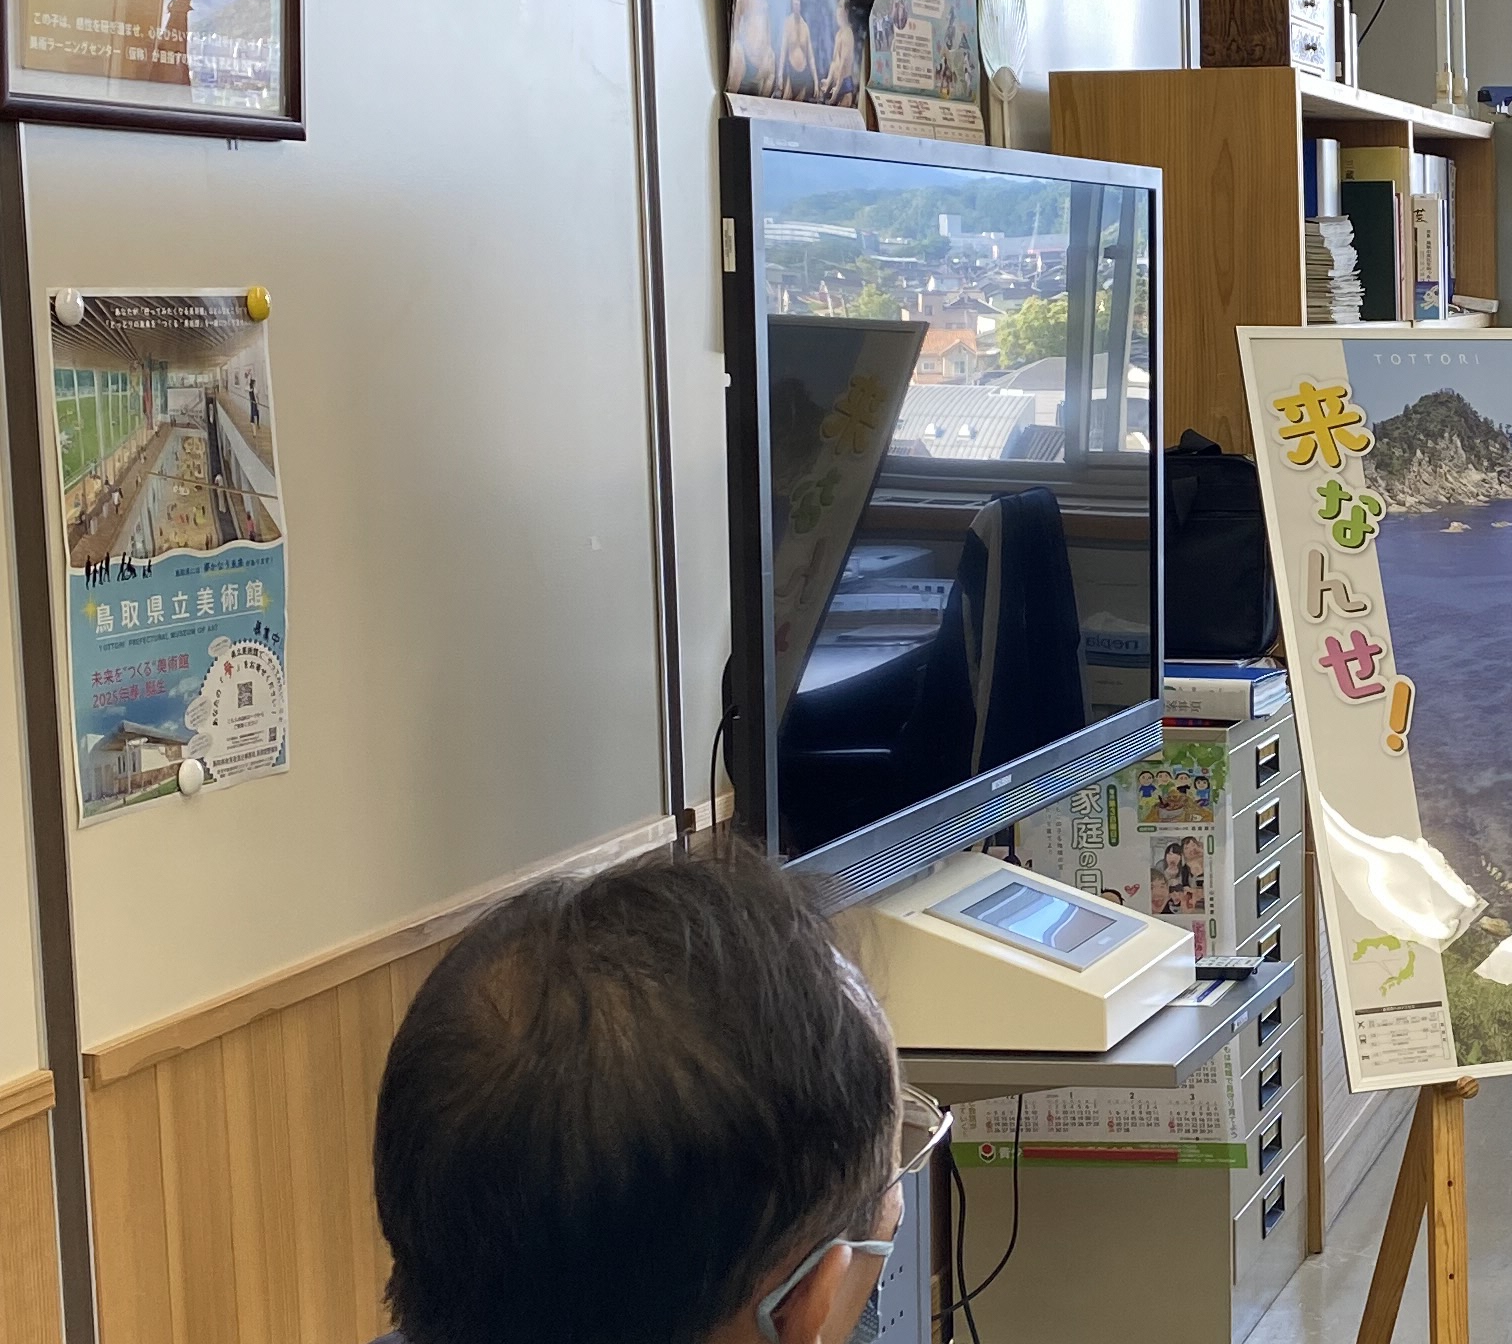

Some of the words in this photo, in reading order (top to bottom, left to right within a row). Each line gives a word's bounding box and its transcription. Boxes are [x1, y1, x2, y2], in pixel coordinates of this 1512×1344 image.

[1375, 354, 1480, 365] TOTTORI
[95, 579, 264, 633] 鳥取県立美術館
